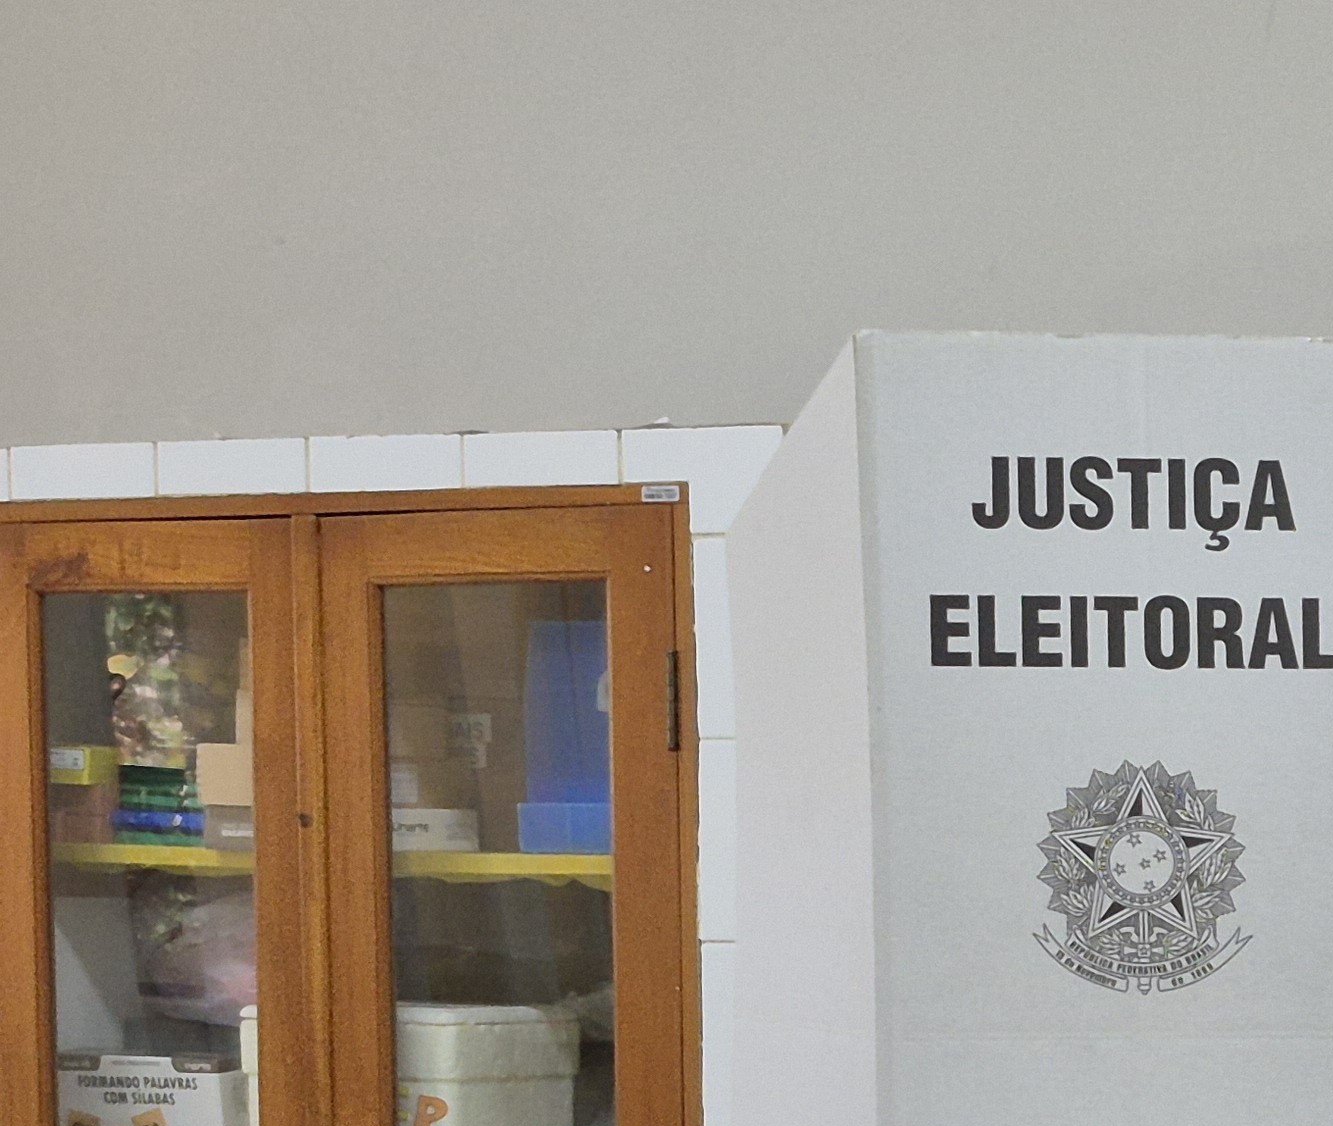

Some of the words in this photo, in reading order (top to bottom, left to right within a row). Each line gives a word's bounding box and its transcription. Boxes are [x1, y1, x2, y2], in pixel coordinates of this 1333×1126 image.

[971, 455, 1297, 552] JUSTIÇA
[78, 1075, 141, 1090] FORMANDO
[143, 1076, 198, 1091] PALAVRAS
[103, 1091, 128, 1105] COM
